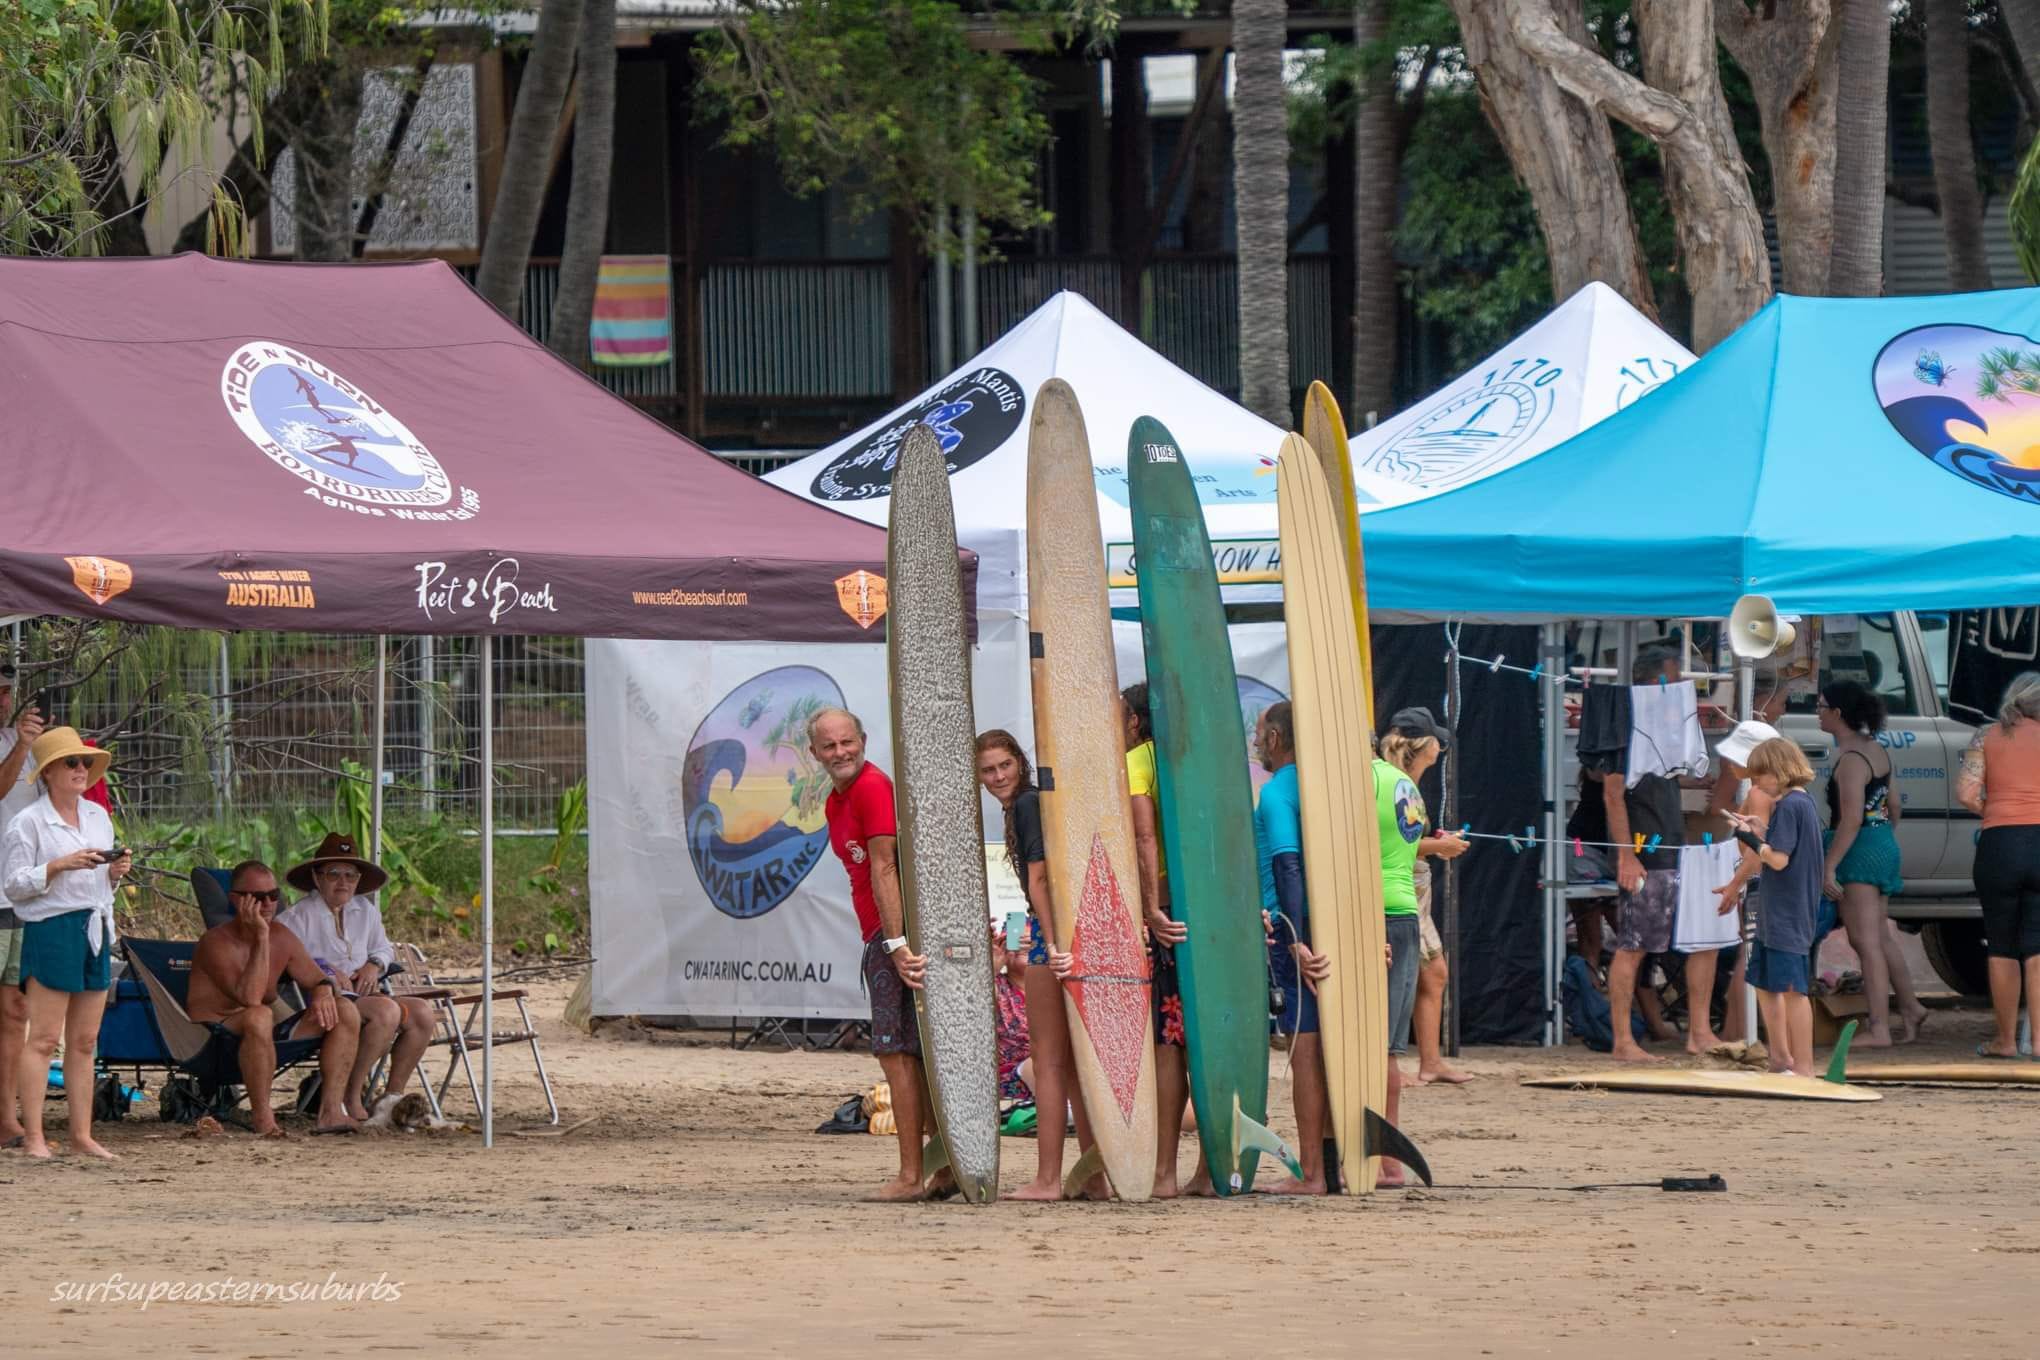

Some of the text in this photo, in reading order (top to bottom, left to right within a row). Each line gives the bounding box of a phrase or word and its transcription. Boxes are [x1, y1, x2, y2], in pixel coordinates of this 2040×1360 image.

[284, 350, 383, 415] TURN
[1484, 358, 1563, 387] 1770
[969, 368, 1023, 413] Mantis
[303, 487, 386, 517] Agnes
[390, 508, 453, 521] Water
[226, 583, 315, 608] AUSTRALIA
[481, 557, 559, 624] Beach
[632, 588, 748, 606] www.reef2beachsurf.com
[1895, 766, 1945, 779] Lessons
[787, 841, 818, 878] INC
[684, 959, 832, 983] CWATARINC.COM.AU
